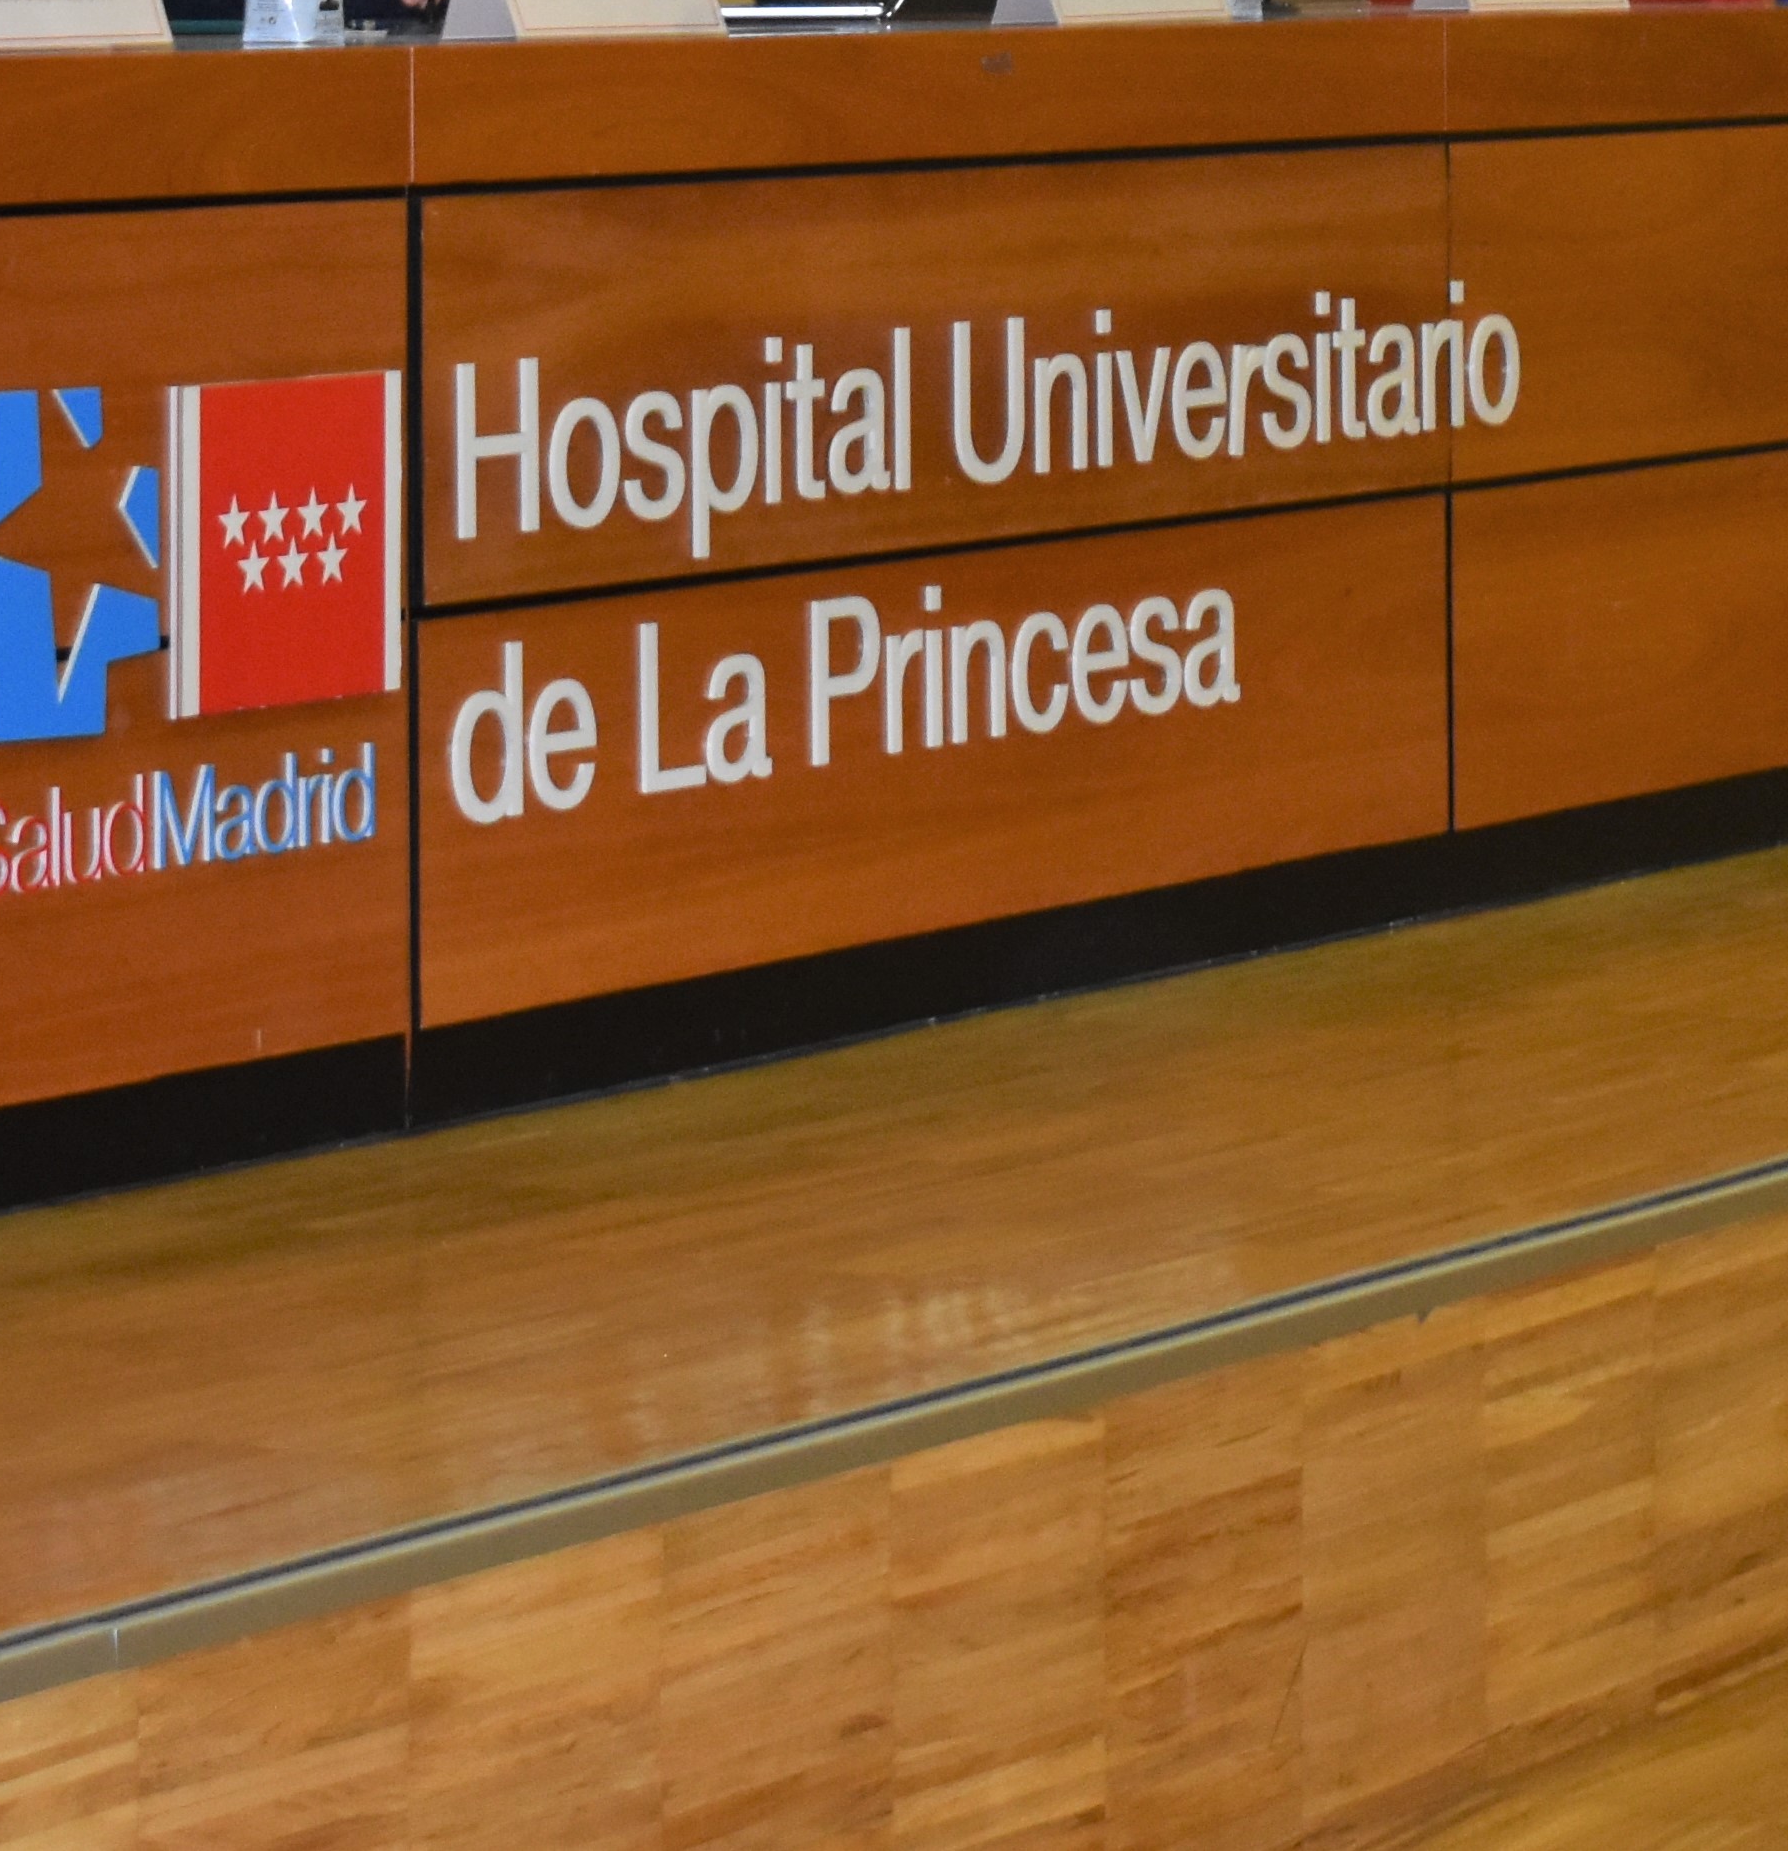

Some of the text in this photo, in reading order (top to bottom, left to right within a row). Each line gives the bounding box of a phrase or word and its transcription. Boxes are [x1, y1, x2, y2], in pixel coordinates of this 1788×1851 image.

[453, 279, 1522, 560] Hospital Universitario
[449, 584, 1241, 825] de La Princesa
